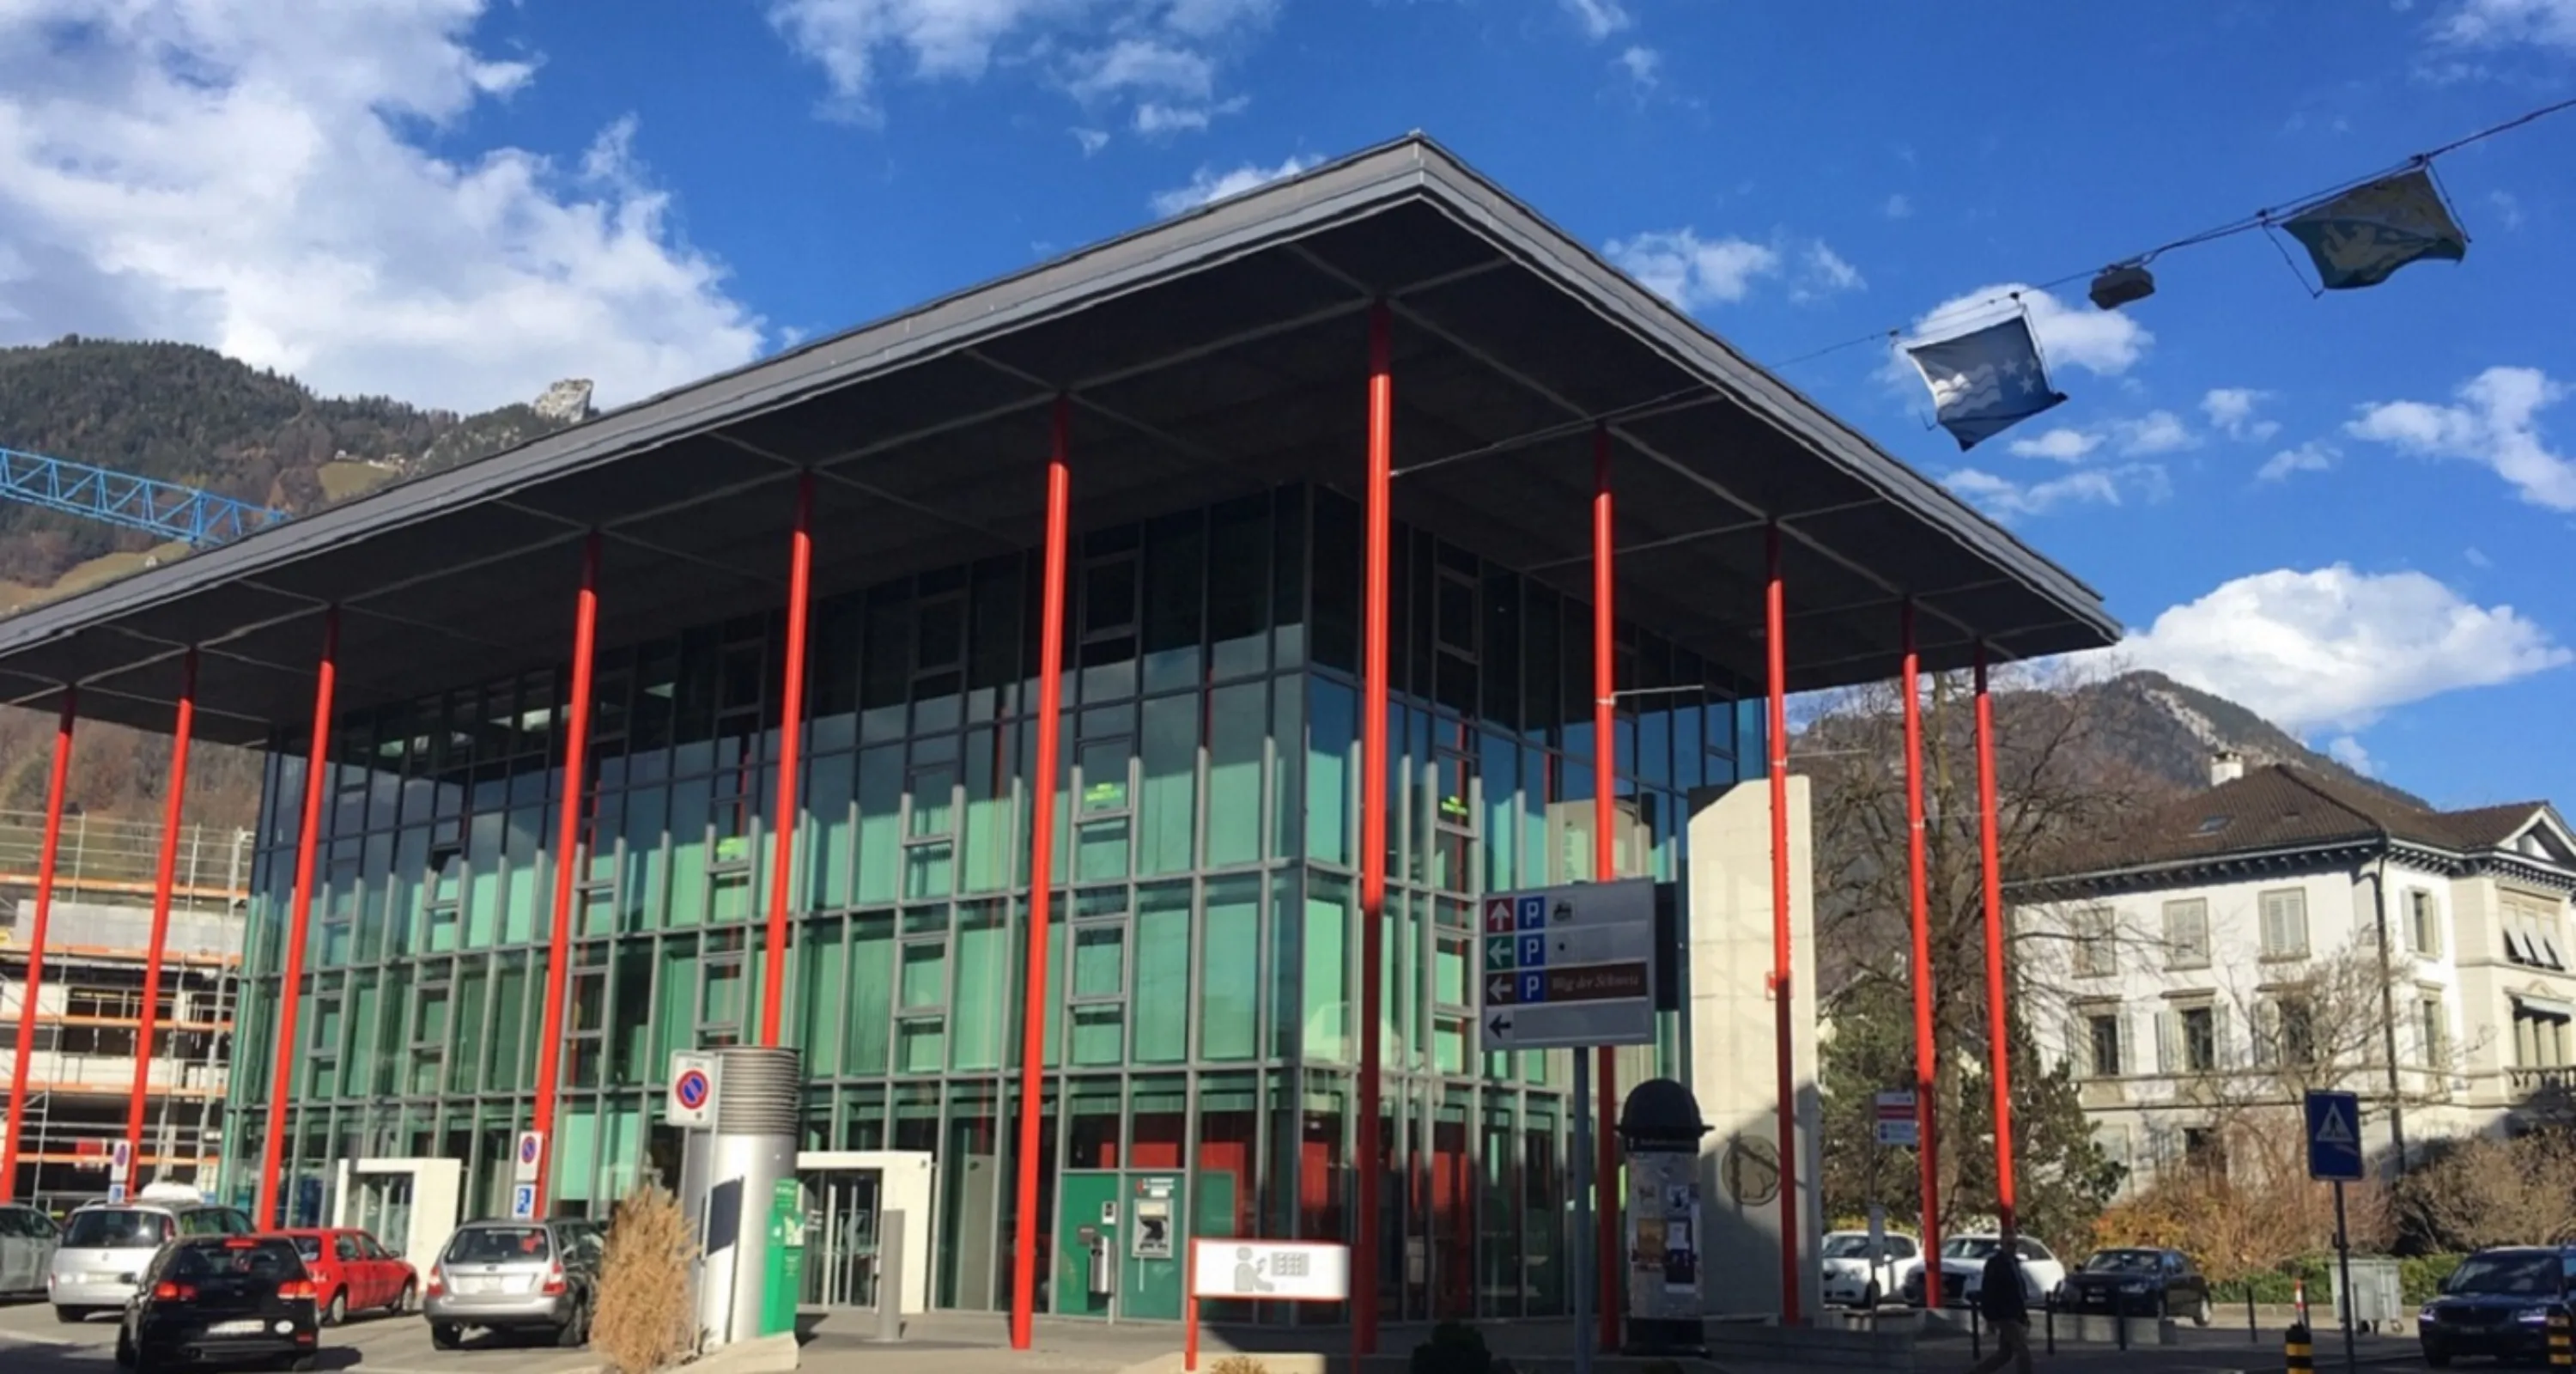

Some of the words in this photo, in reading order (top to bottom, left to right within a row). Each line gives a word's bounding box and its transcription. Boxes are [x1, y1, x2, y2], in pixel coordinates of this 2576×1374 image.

[1527, 902, 1539, 927] P
[1527, 938, 1539, 964] P
[1527, 976, 1539, 999] P
